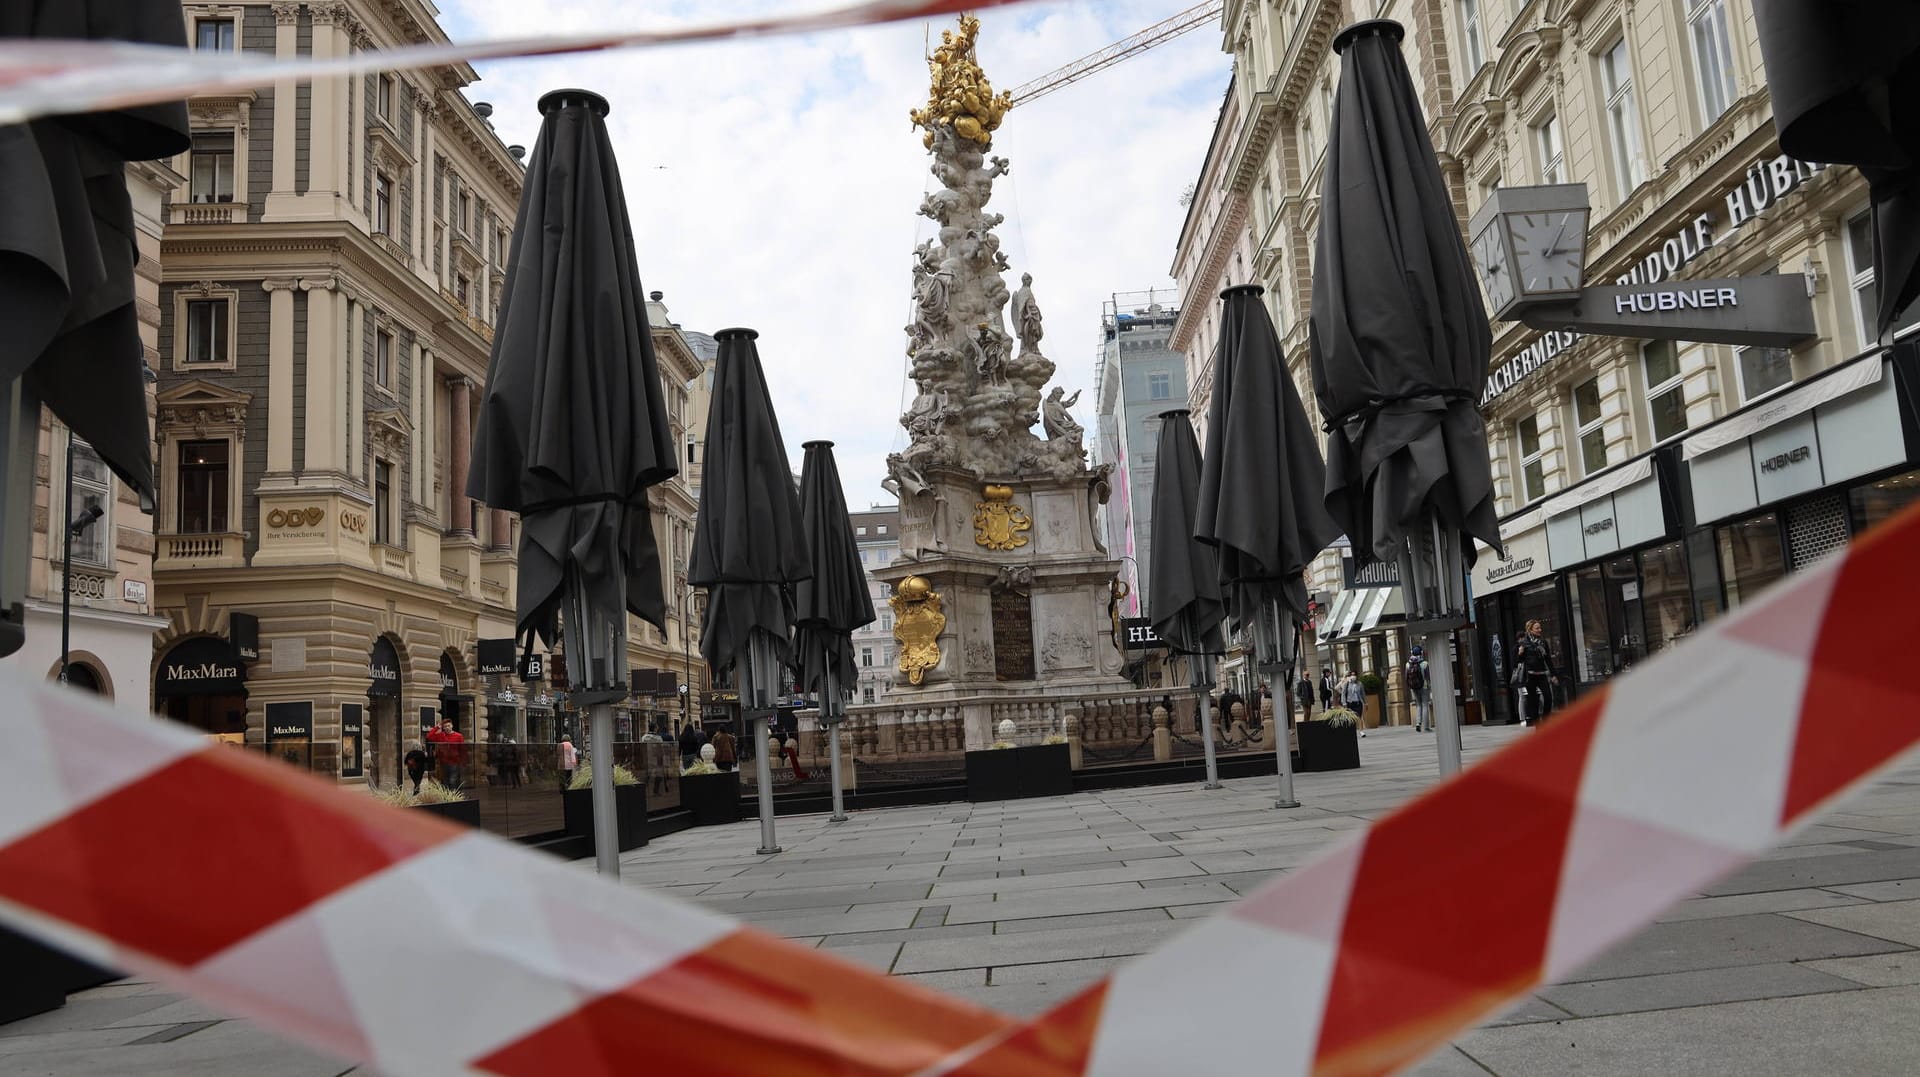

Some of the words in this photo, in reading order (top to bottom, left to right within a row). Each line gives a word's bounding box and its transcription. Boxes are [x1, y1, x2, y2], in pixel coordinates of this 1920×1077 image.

[1615, 288, 1737, 313] HÜBNER
[1128, 626, 1163, 642] HE
[167, 663, 237, 681] MaxMara
[481, 665, 511, 673] MaxMara
[273, 726, 305, 735] MaxMara
